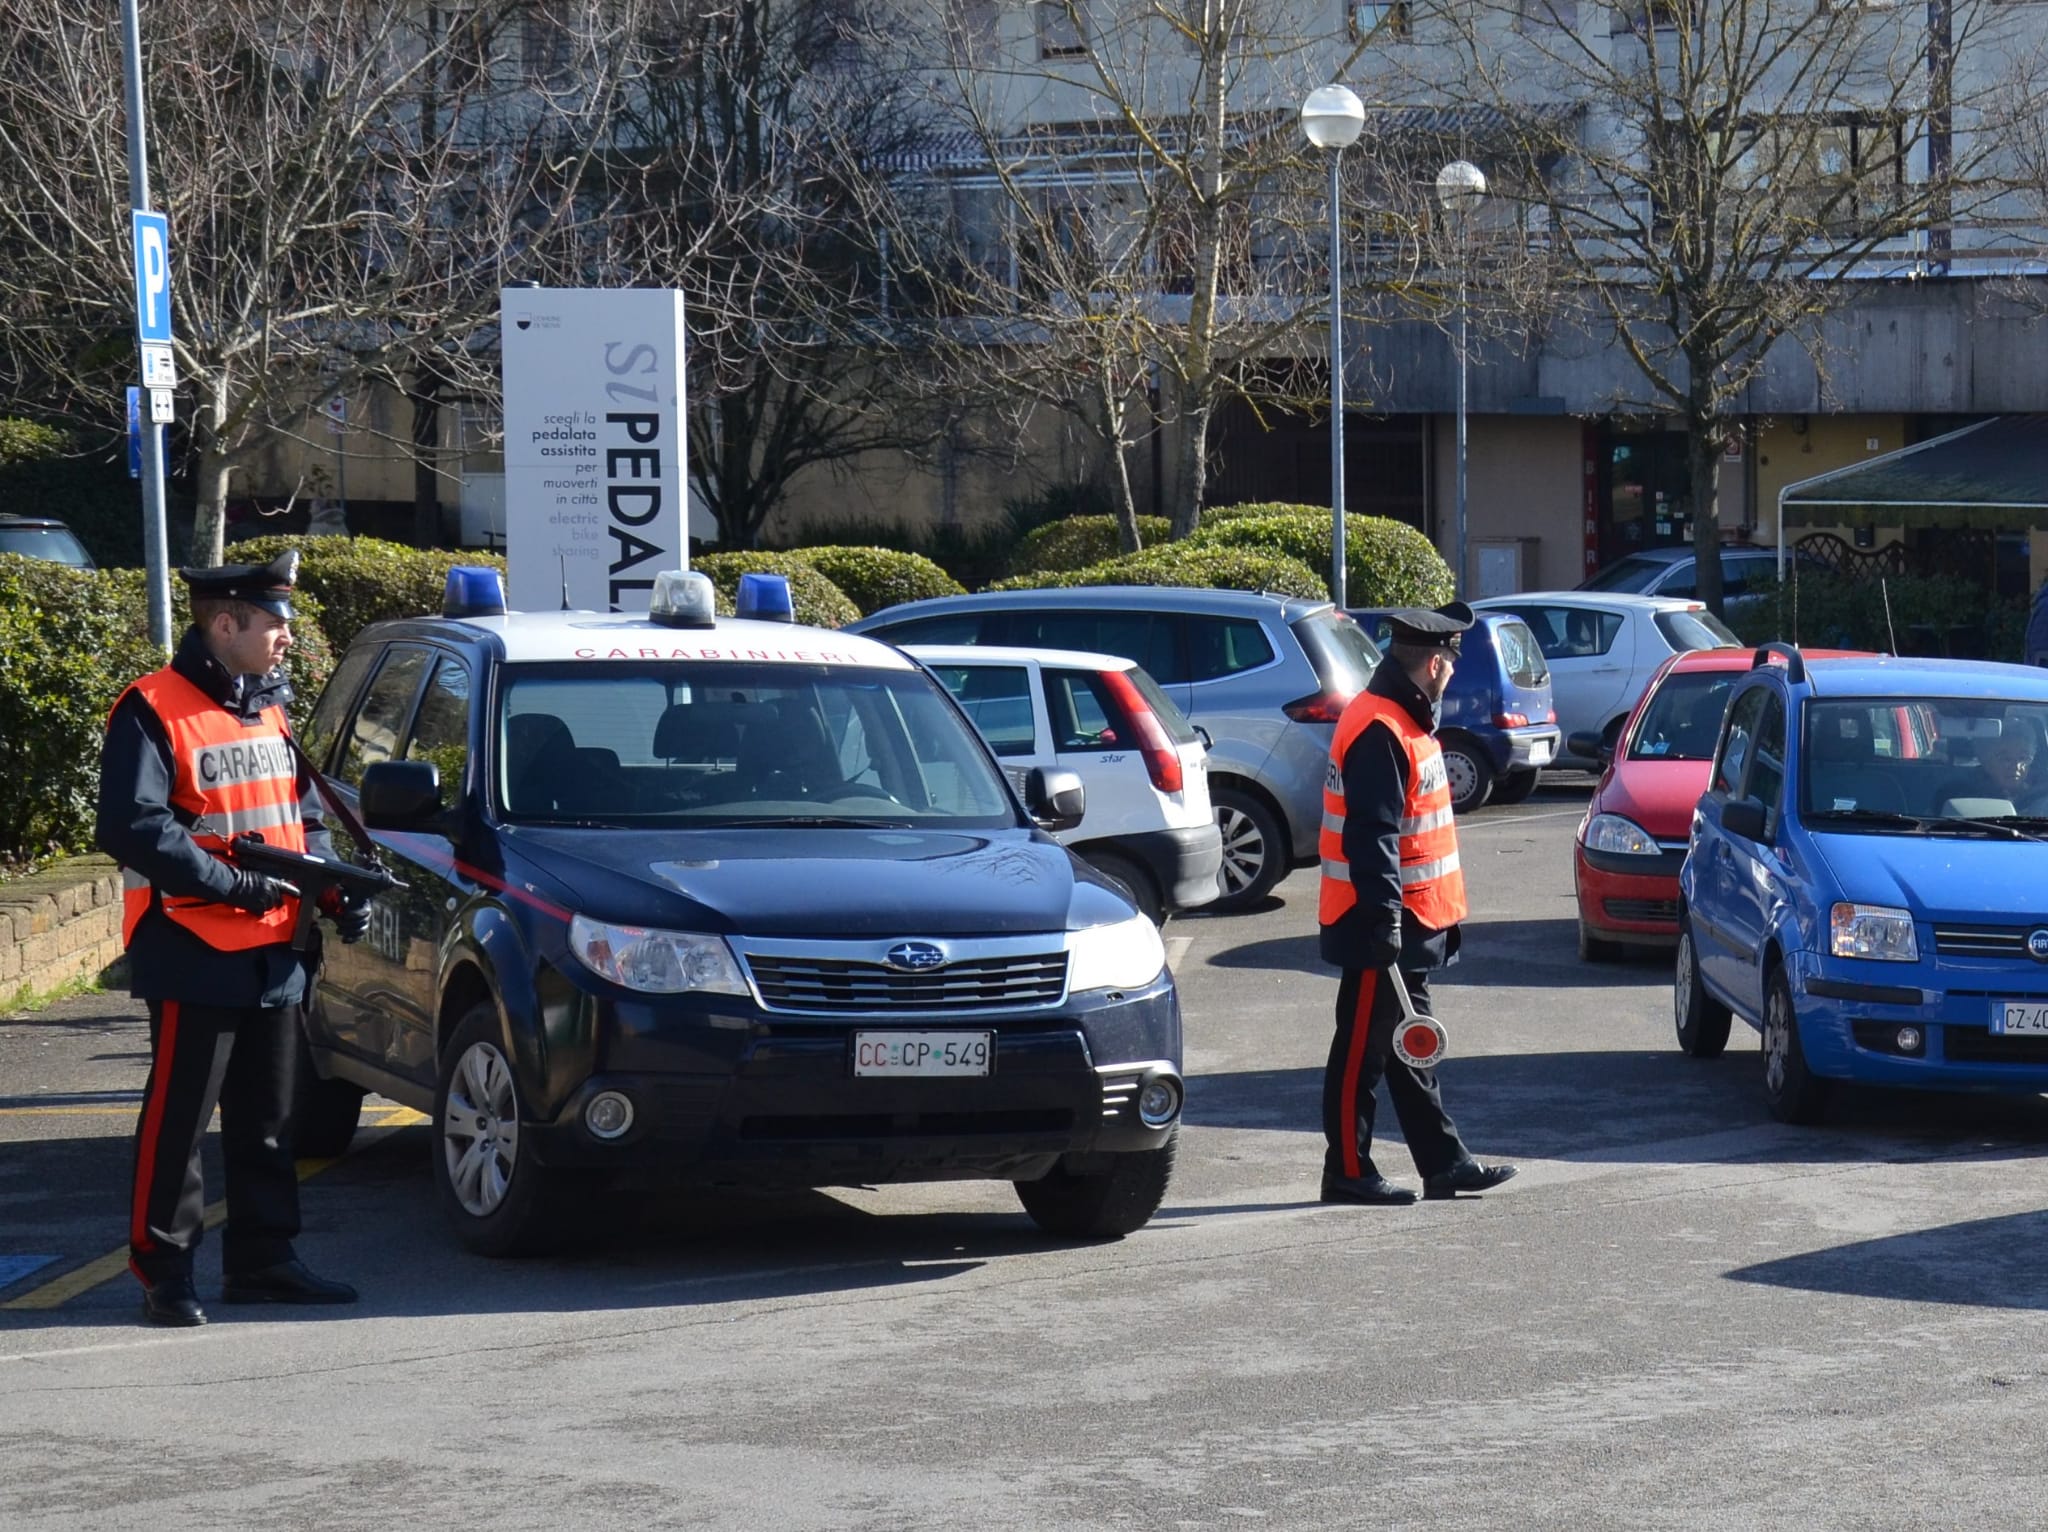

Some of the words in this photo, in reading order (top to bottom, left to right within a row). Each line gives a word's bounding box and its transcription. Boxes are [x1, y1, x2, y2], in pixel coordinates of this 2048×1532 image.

[142, 226, 165, 328] P
[543, 411, 580, 428] scegli
[584, 411, 596, 424] la
[532, 428, 597, 443] pedalata
[541, 446, 597, 457] assistita
[575, 463, 597, 475] per
[543, 478, 598, 489] muoverti
[556, 494, 567, 505] in
[571, 494, 598, 505] città
[549, 512, 599, 525] electric
[1585, 459, 1595, 564] BIRR
[572, 529, 598, 541] bike
[552, 546, 599, 561] sharing
[575, 648, 859, 663] CARABINIERI
[200, 743, 291, 783] CARABINIE
[1100, 754, 1126, 764] star
[2033, 939, 2048, 949] FIA
[2006, 1009, 2026, 1029] CZ
[859, 1042, 887, 1067] CC
[903, 1042, 930, 1067] CP
[944, 1042, 987, 1067] 549
